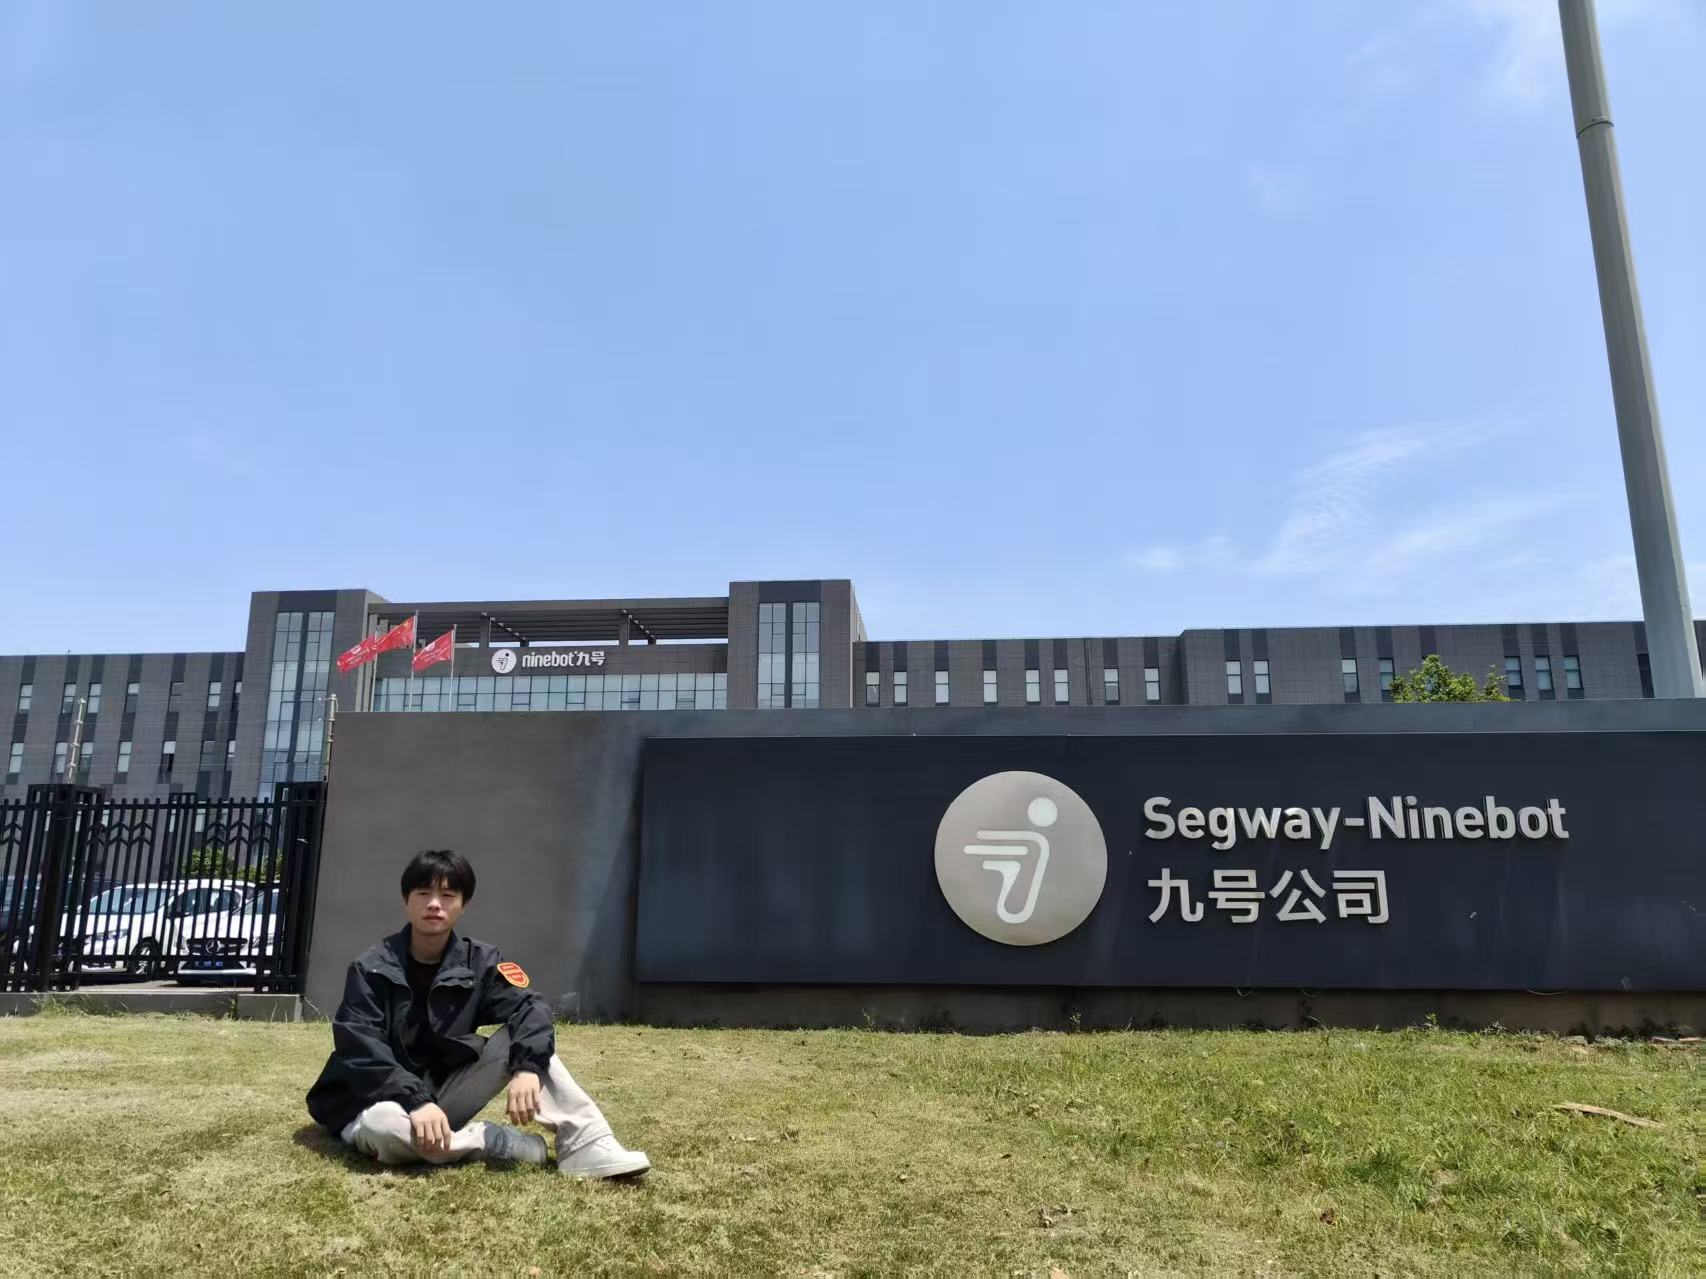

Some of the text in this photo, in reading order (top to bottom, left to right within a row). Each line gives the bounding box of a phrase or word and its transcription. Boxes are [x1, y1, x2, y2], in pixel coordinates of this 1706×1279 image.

[522, 650, 606, 668] ninebot 九号
[1143, 795, 1570, 850] Segway-Ninebot
[1147, 867, 1390, 924] 九号公司
